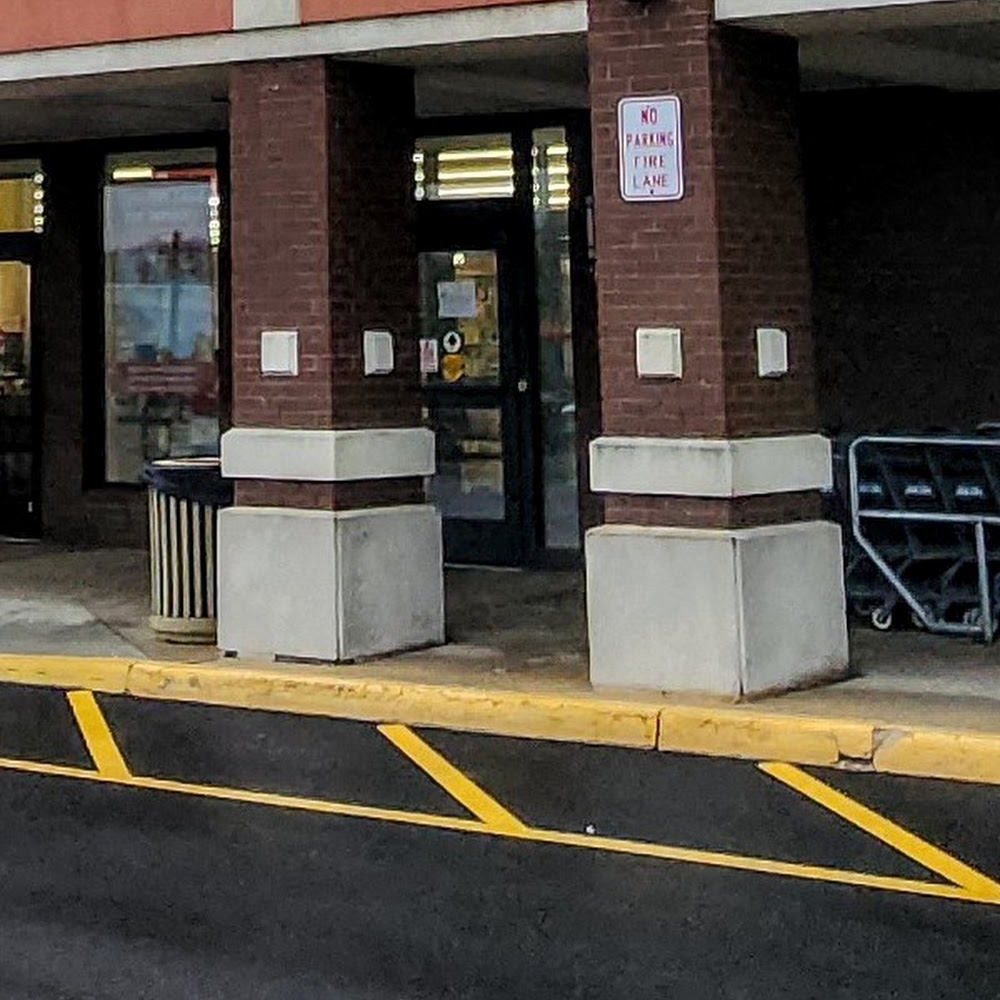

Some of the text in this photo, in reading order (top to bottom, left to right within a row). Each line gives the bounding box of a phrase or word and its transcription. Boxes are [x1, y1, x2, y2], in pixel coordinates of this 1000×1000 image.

[641, 107, 658, 125] NO
[626, 132, 674, 147] PARKING
[632, 175, 668, 188] LANE
